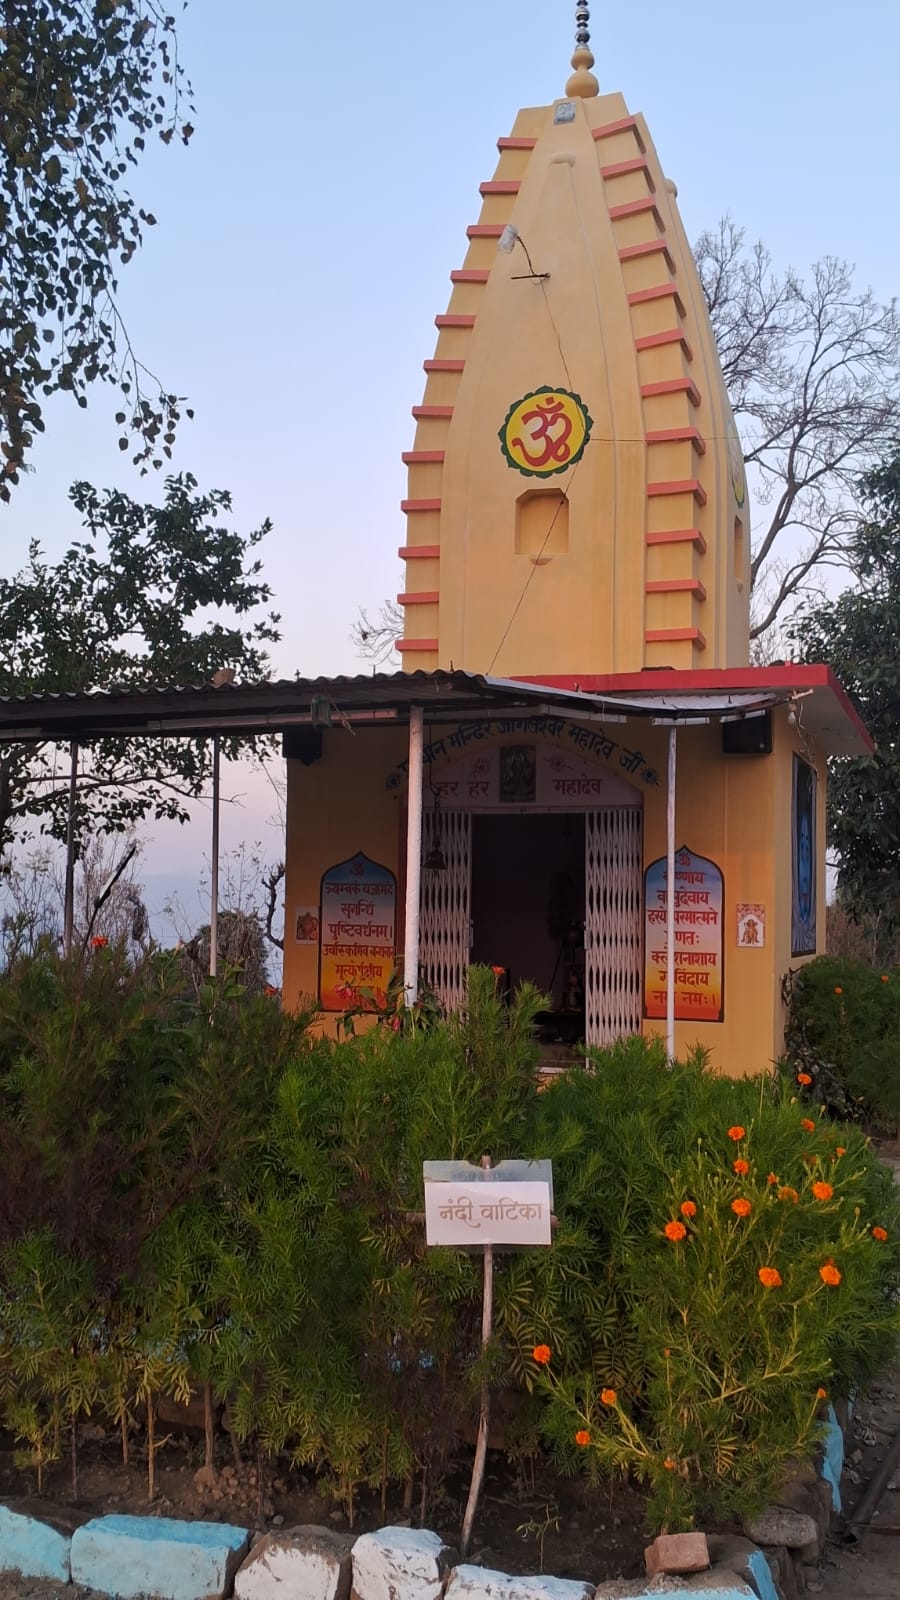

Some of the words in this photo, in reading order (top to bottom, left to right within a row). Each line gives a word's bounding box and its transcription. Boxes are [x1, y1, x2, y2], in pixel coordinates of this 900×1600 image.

[512, 397, 572, 467] ॐ
[568, 723, 620, 760] महादेव
[618, 745, 647, 774] जी
[466, 781, 490, 799] हर
[552, 773, 602, 796] महादेव
[438, 1196, 481, 1228] नंदी
[479, 1197, 543, 1221] वाटिका
